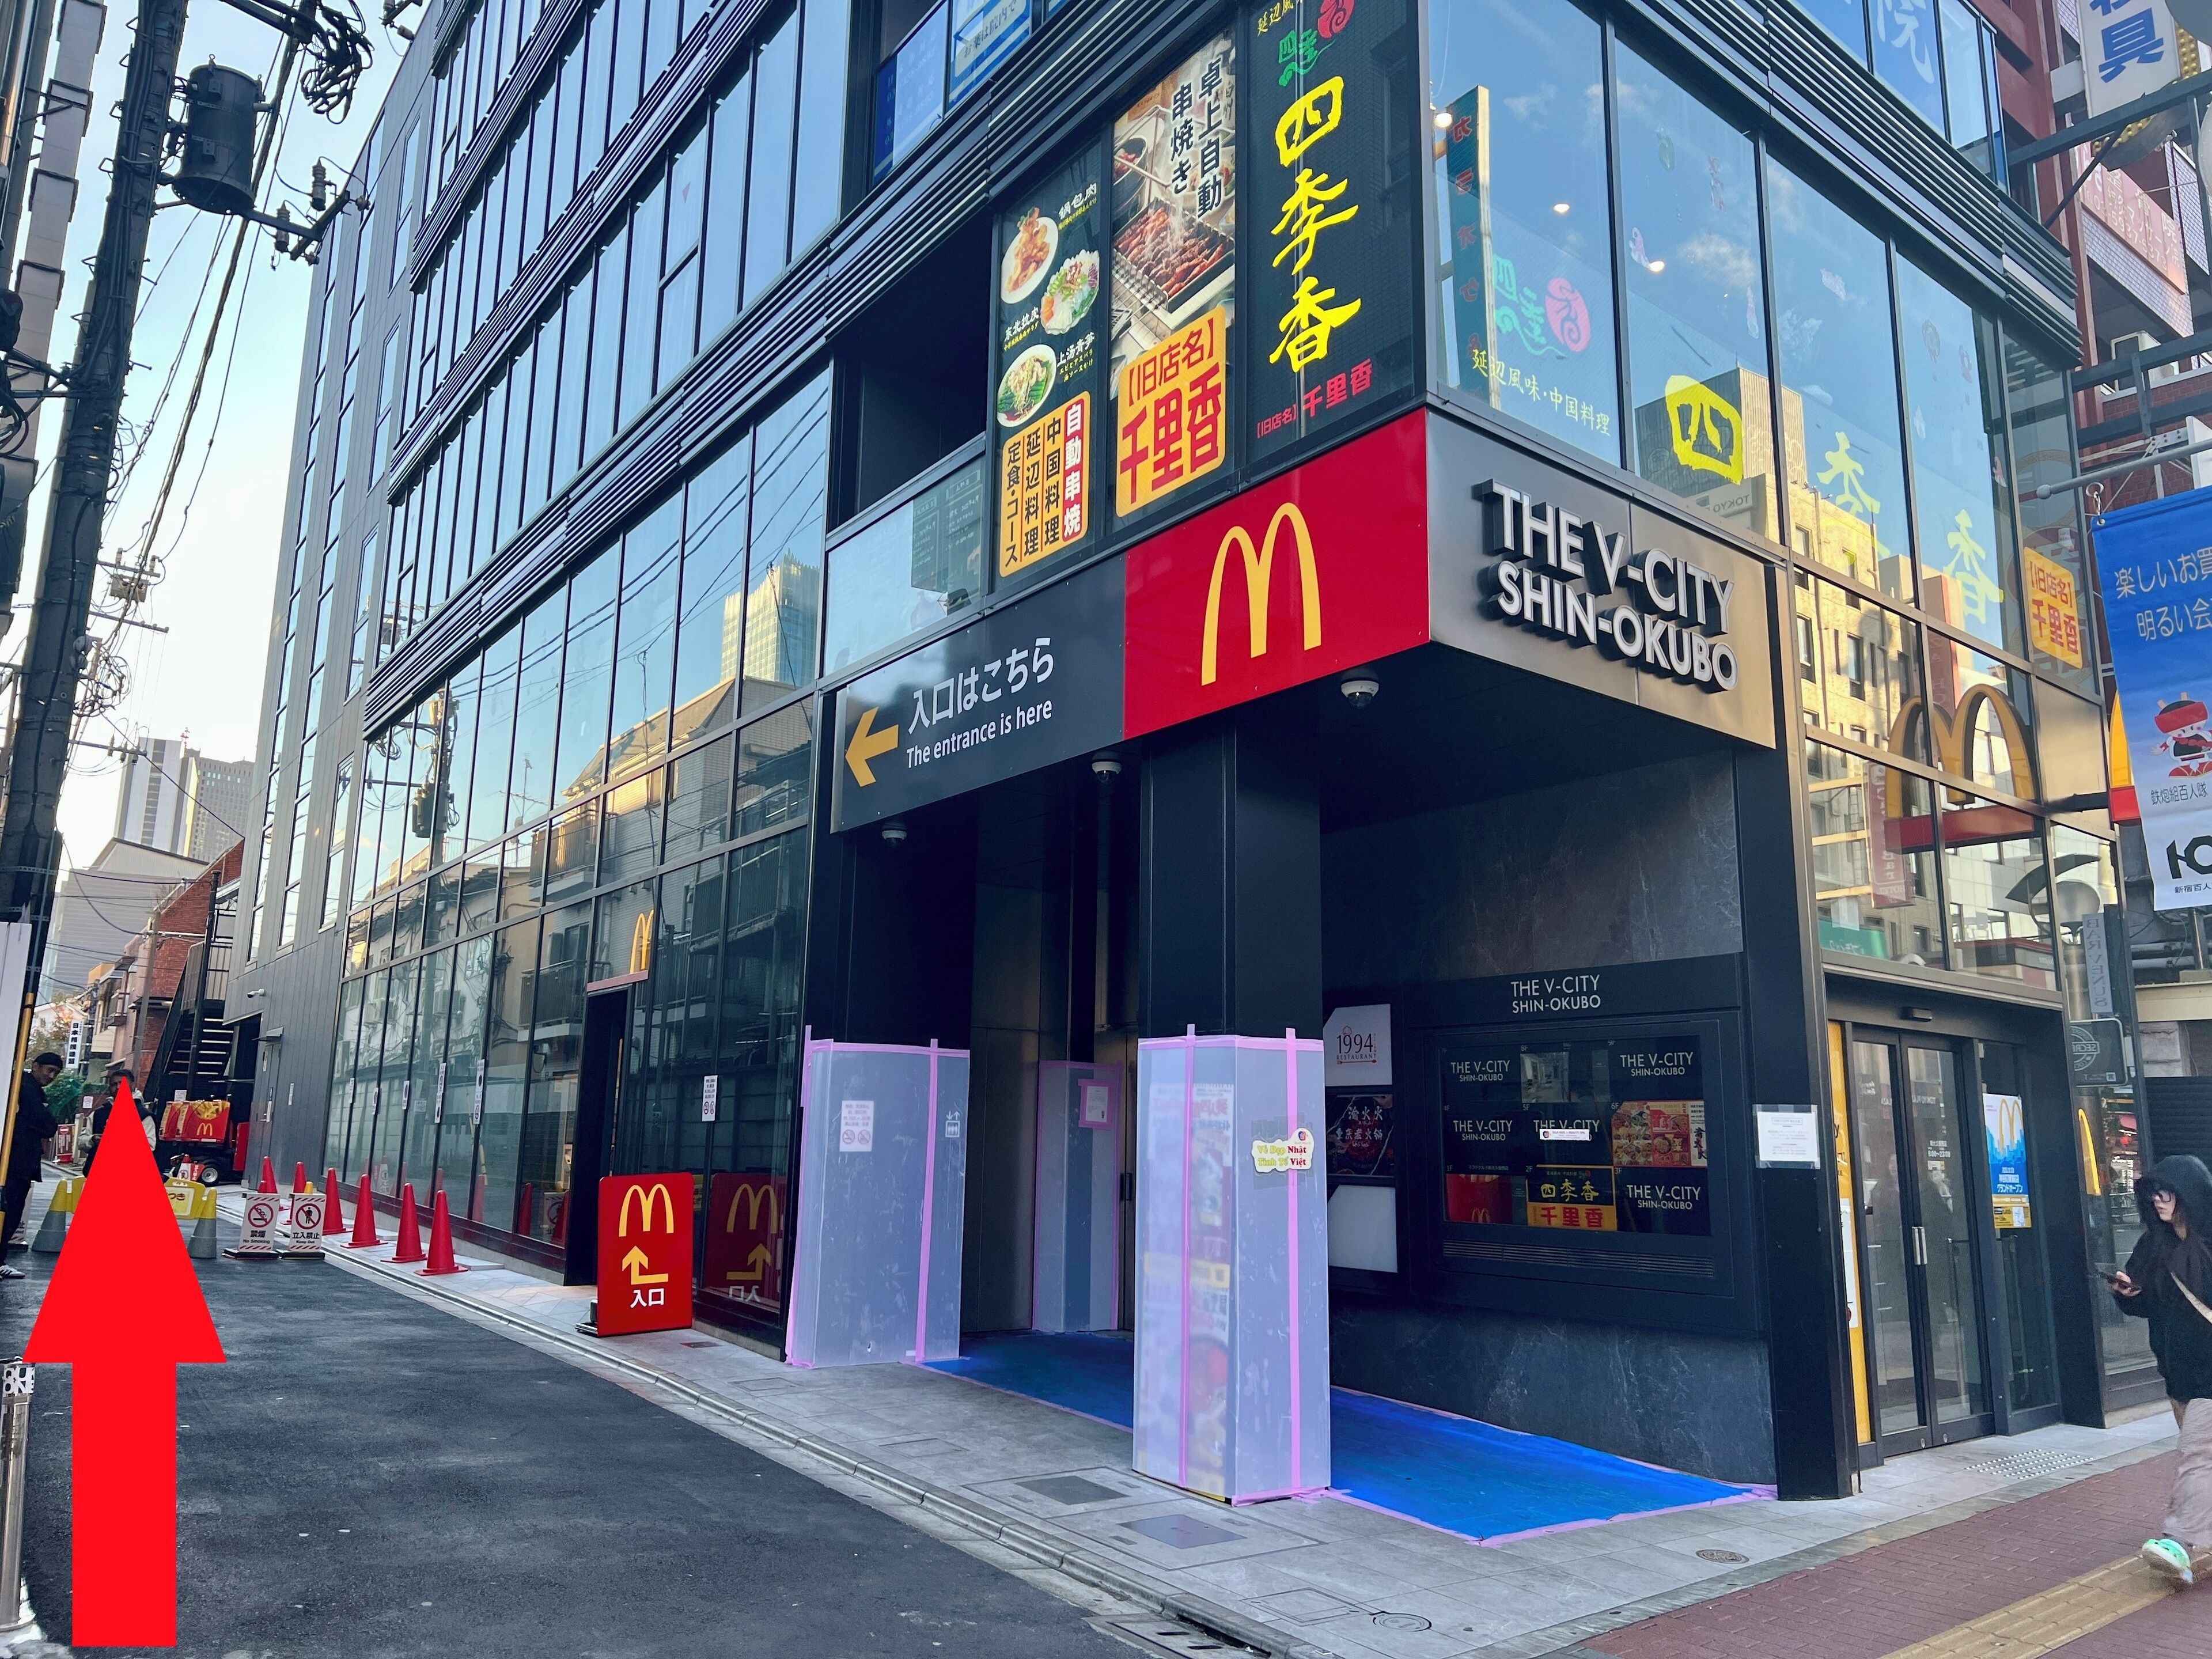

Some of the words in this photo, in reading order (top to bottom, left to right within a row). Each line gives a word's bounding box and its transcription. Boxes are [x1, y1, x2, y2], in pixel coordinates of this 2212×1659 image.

[1171, 82, 1194, 195] 串焼き
[1198, 58, 1222, 218] 卓上自動
[1269, 75, 1363, 373] 四季香
[1302, 357, 1373, 418] 千里香
[1119, 362, 1222, 505] 千里香
[1044, 416, 1061, 547] 中国料理
[1064, 403, 1082, 539] 自動串焼
[1024, 426, 1041, 557] 延辺料理
[1490, 478, 1585, 578] THE
[1590, 520, 1735, 634] V-CITY
[1498, 560, 1739, 691] SHIN-OKUBO
[2032, 598, 2079, 654] 千里香
[908, 637, 1054, 735] 入口はこちら
[907, 745, 930, 768] The
[934, 722, 996, 759] entrance
[1000, 713, 1012, 736] is
[1016, 700, 1053, 730] here
[2174, 882, 2212, 894] 新宿百人
[1511, 980, 1540, 997] THE
[1544, 974, 1601, 995] V-CITY
[1512, 994, 1601, 1014] SHIN-OKUBO
[1336, 1033, 1373, 1054] 1994
[1450, 1062, 1471, 1074] THE
[1474, 1060, 1510, 1073] V-CITY
[1620, 1054, 1645, 1067] THE
[1647, 1052, 1694, 1066] V-CITY
[1459, 1073, 1503, 1082] SHIN-OKUBO
[1631, 1067, 1685, 1077] SHIN-OKUBO
[1611, 1102, 1619, 1110] 6F
[1453, 1120, 1474, 1133] THE
[1476, 1120, 1513, 1133] V-CITY
[1462, 1132, 1506, 1141] SHIN-OKUBO
[1287, 1146, 1306, 1156] Nhật
[1290, 1158, 1306, 1168] Việt
[1540, 1178, 1599, 1203] 四季香
[1626, 1184, 1652, 1199] THE
[1654, 1185, 1701, 1200] V-CITY
[1638, 1200, 1693, 1210] SHIN-OKUBO
[1540, 1206, 1603, 1229] 千里香
[250, 1230, 266, 1238] 禁煙
[630, 1288, 665, 1308] 入口
